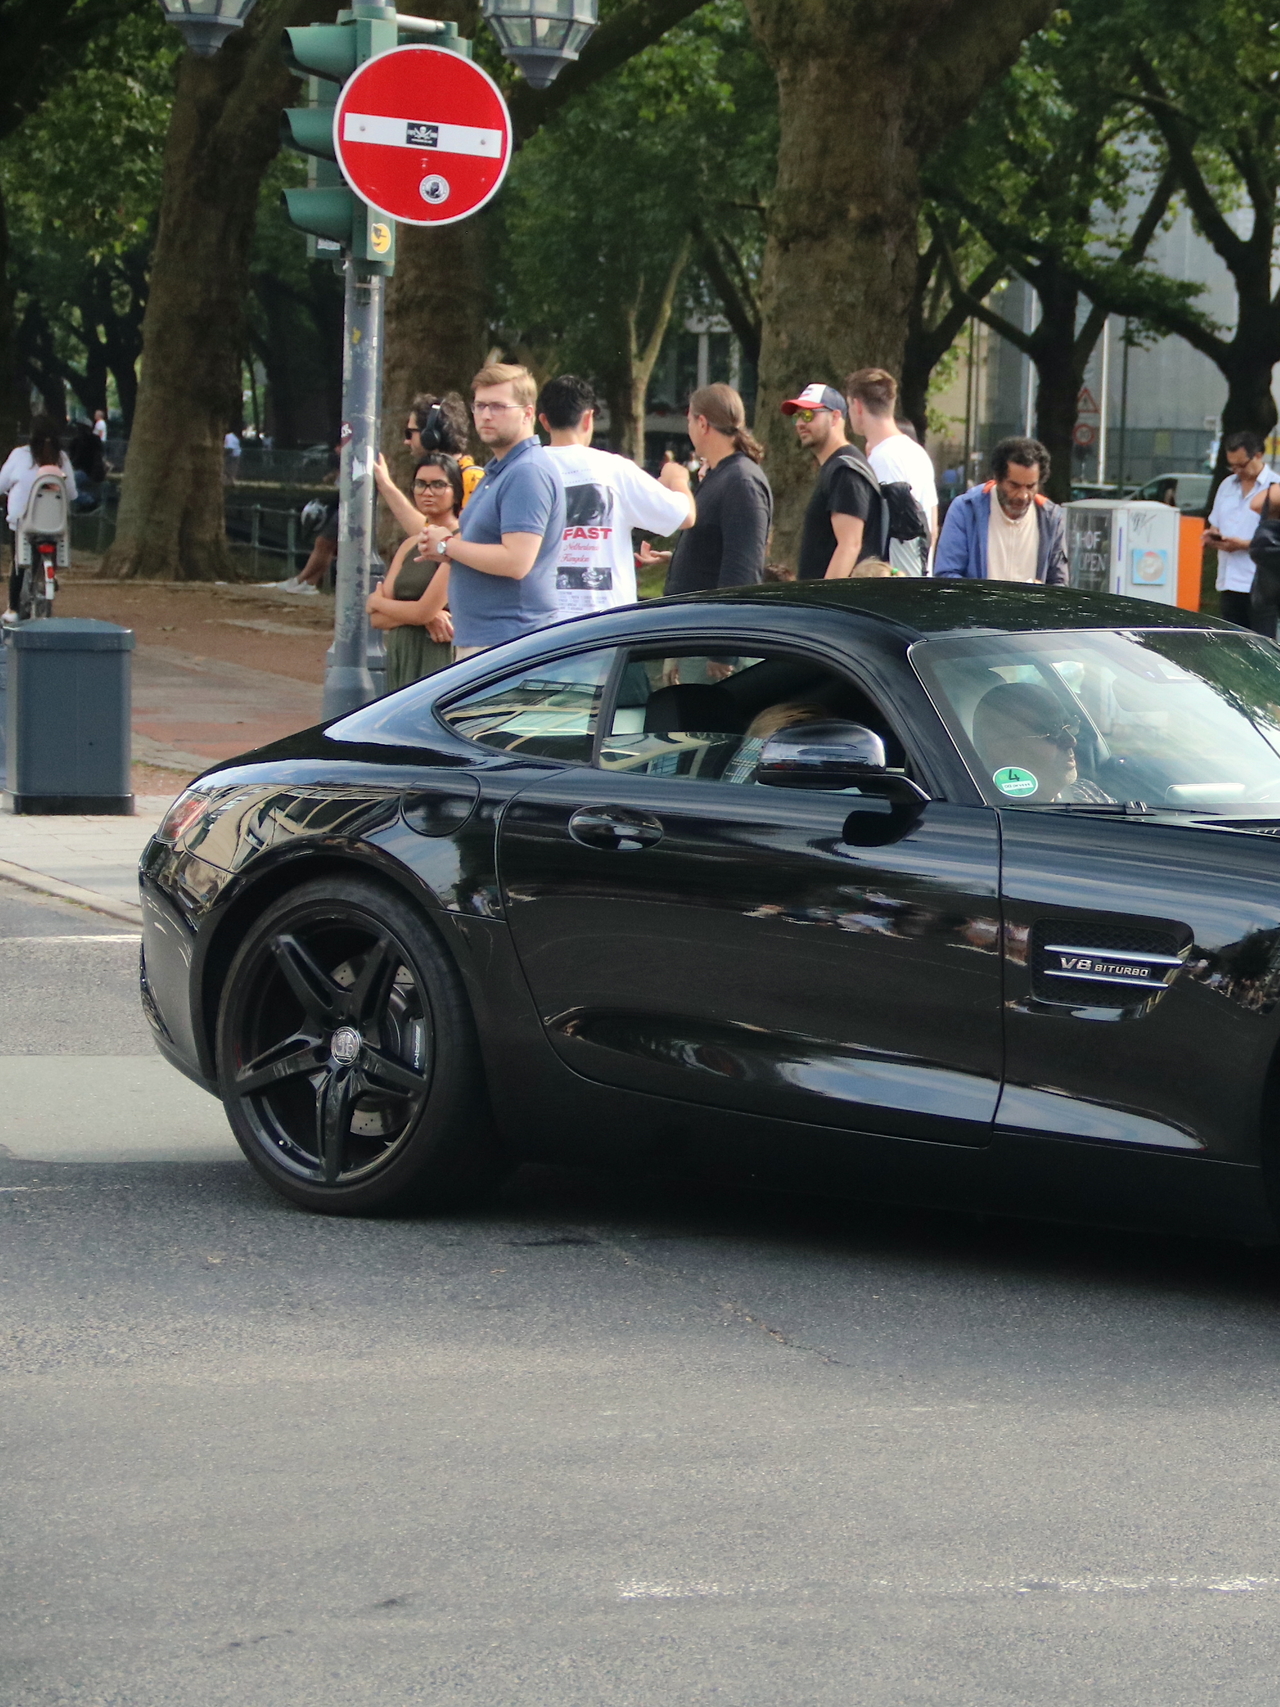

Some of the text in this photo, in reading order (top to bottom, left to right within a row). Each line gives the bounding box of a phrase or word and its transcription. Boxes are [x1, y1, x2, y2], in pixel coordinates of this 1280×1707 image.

[562, 527, 612, 541] FAST
[1008, 769, 1020, 781] 4
[1060, 957, 1150, 977] V8 BITURBO
